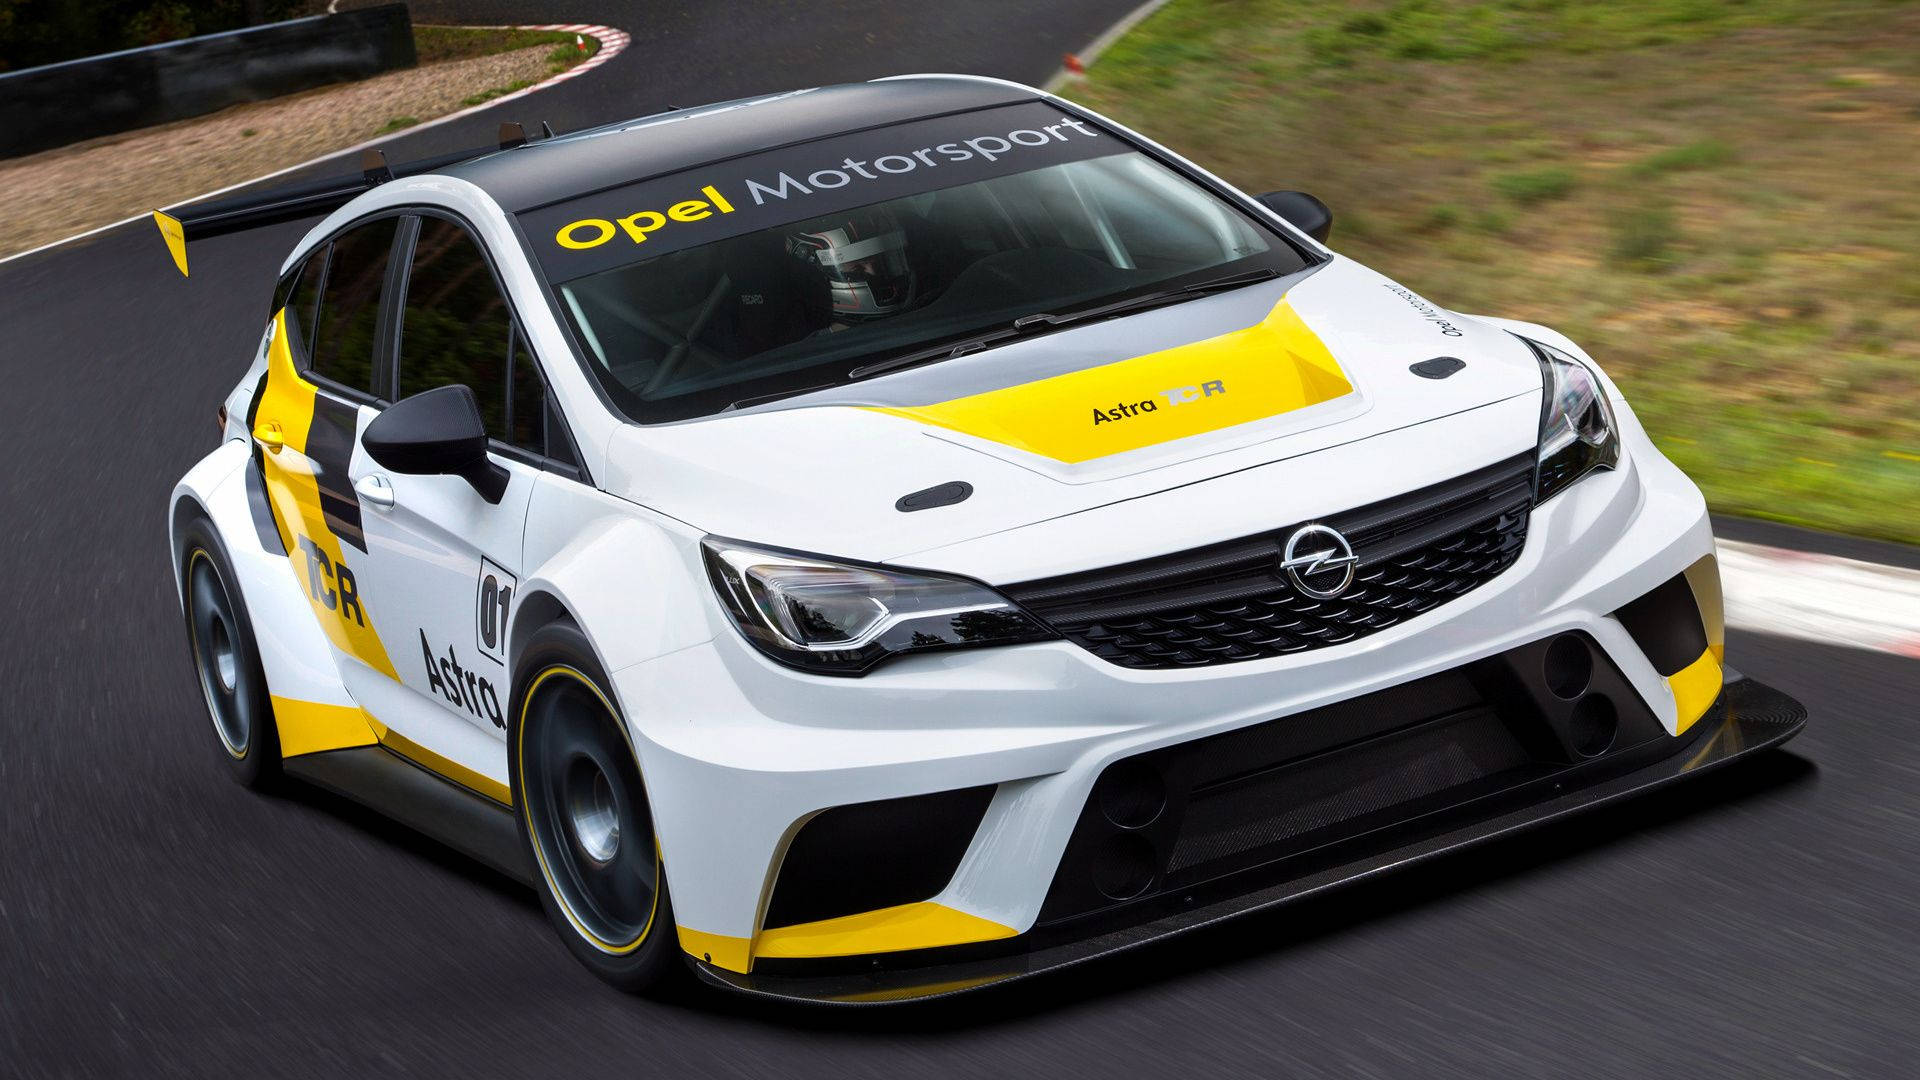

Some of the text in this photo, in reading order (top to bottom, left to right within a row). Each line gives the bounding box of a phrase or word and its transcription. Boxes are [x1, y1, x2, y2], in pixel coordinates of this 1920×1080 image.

[555, 117, 1097, 250] Opel Motorsport
[1093, 379, 1226, 426] Astra TCR
[298, 533, 365, 628] TCR
[481, 574, 512, 656] 01
[419, 628, 507, 731] Astra
